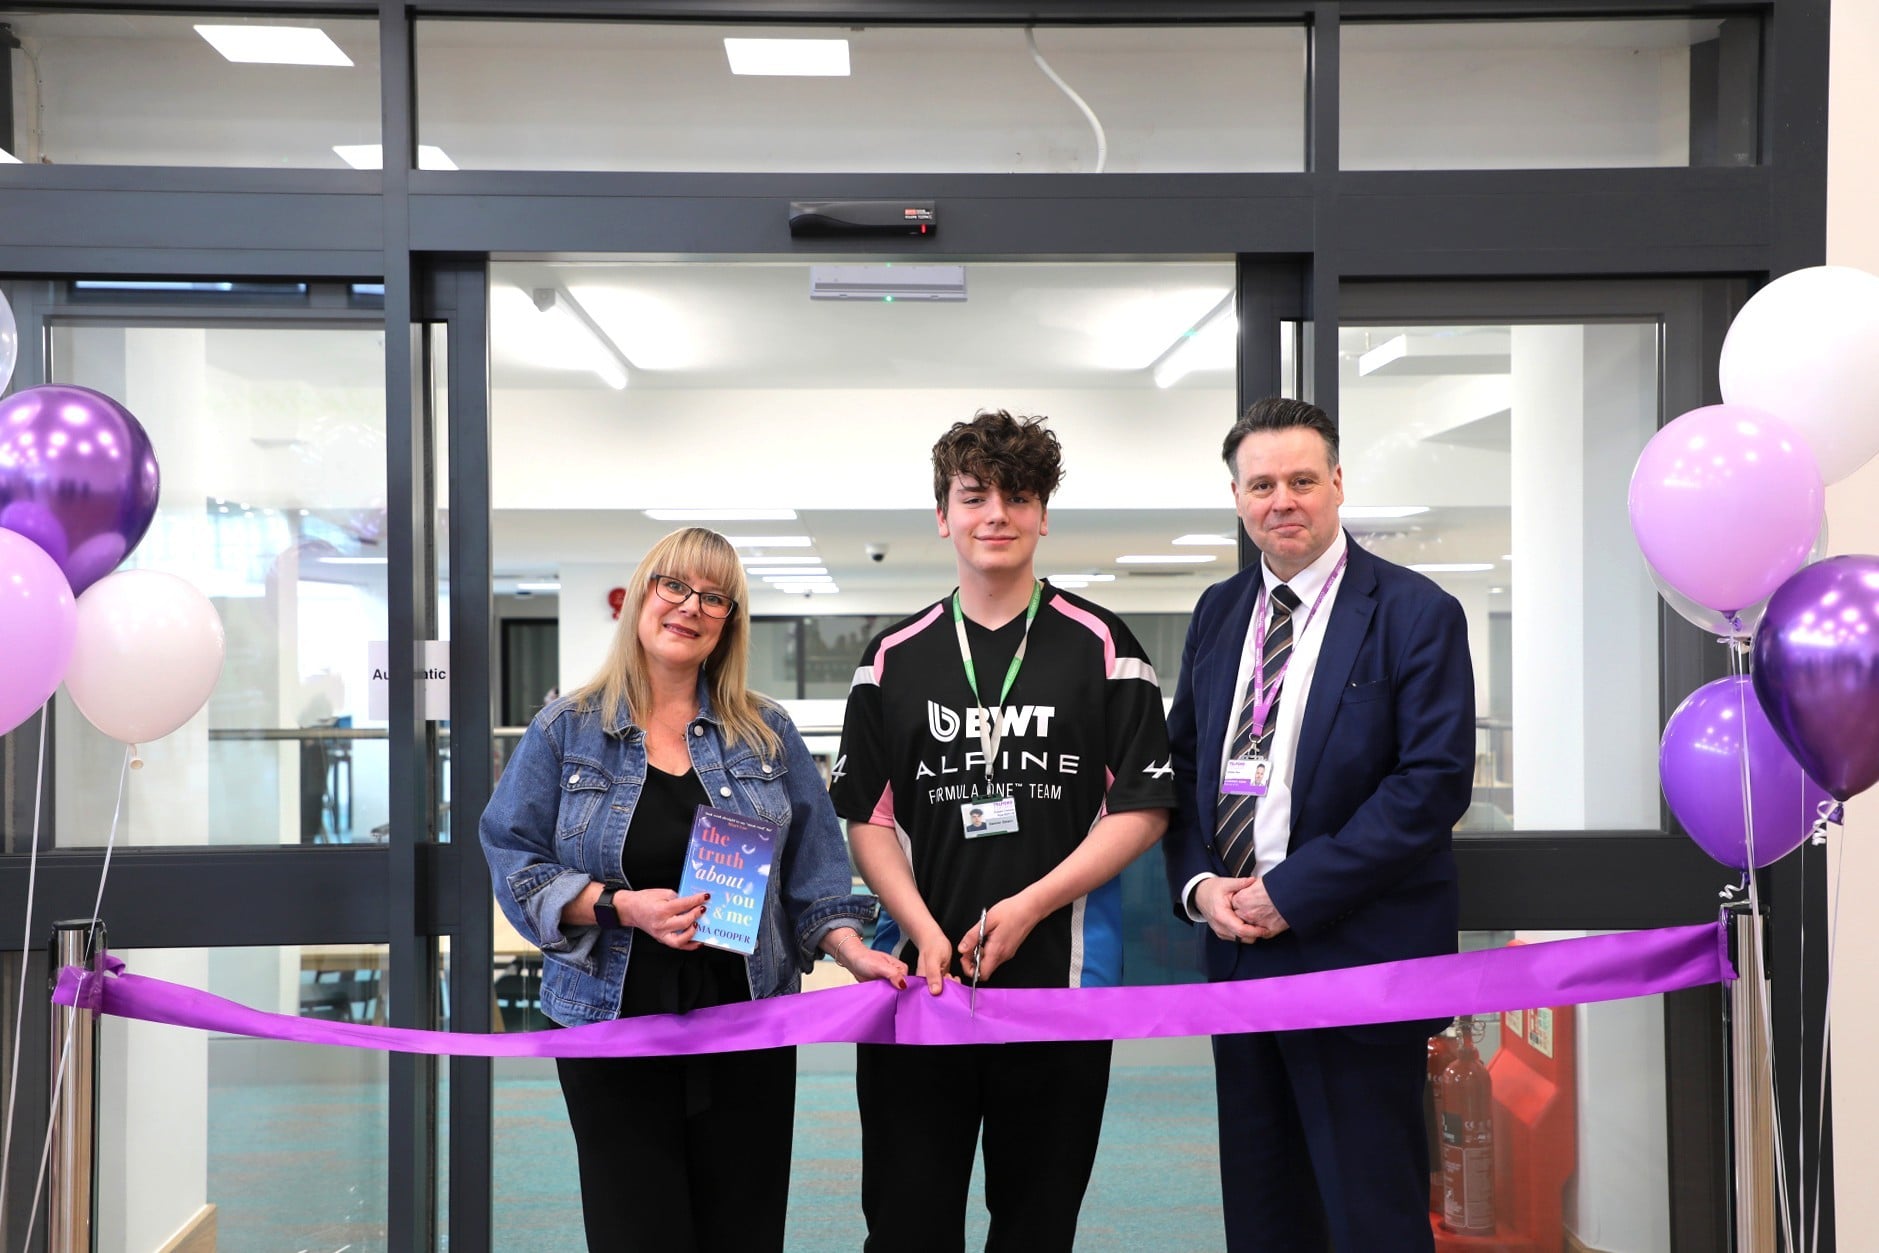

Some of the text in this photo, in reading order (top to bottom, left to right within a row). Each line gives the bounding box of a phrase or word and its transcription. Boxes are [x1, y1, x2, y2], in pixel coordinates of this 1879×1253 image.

[372, 668, 447, 680] Auatic
[965, 705, 1055, 738] BWT
[1029, 784, 1062, 800] TEAM
[701, 827, 731, 847] the
[698, 846, 745, 869] truth
[695, 865, 744, 889] about
[724, 891, 755, 909] you
[726, 911, 753, 927] me
[714, 927, 751, 944] COOPER
